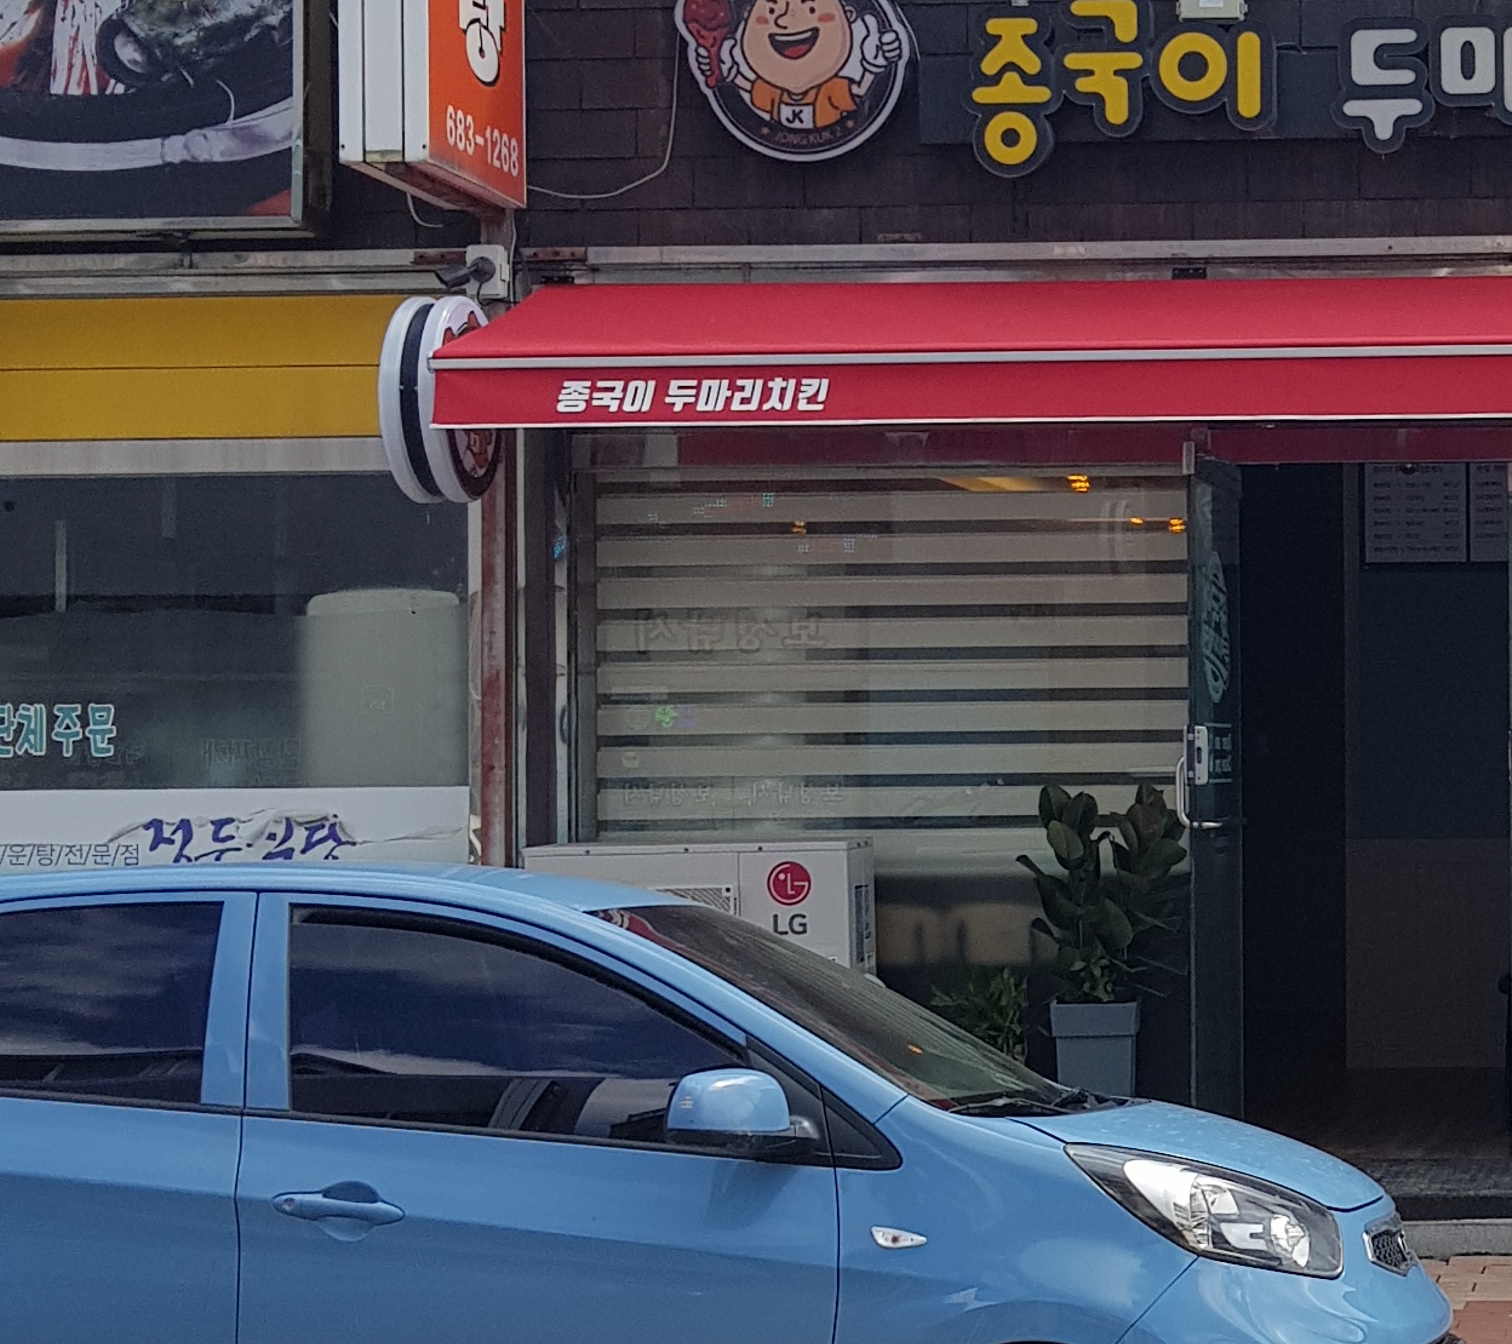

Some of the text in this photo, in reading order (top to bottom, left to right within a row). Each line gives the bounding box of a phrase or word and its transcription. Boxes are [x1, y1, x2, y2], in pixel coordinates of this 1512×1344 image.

[785, 109, 804, 124] JK
[446, 104, 519, 177] 683-1268
[556, 377, 829, 413] 종국이 두마리치킨
[52, 703, 117, 758] 주문
[772, 913, 808, 935] LG
